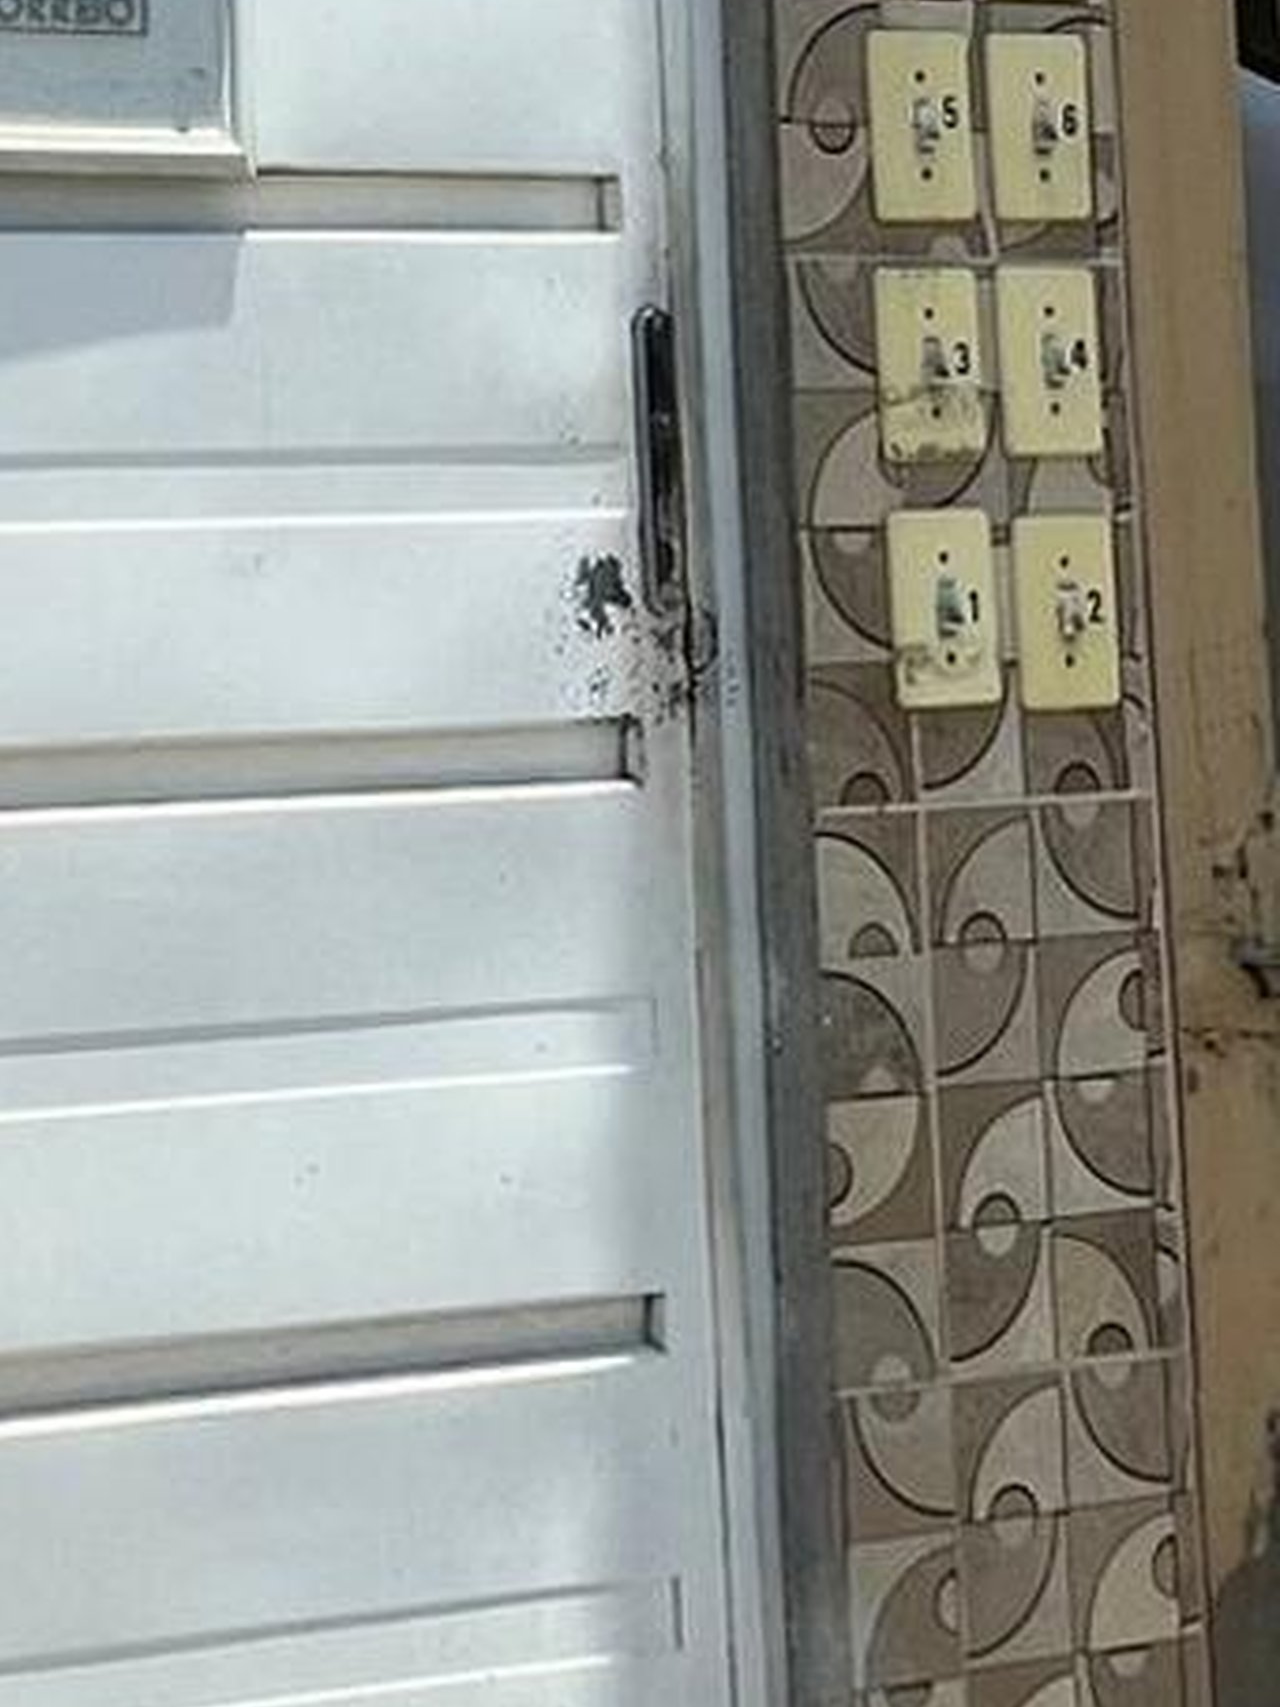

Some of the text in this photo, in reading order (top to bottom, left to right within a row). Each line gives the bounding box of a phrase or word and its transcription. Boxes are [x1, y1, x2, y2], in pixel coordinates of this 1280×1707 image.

[942, 95, 959, 129] 5
[1062, 102, 1079, 136] 6
[953, 341, 971, 376] 3
[1068, 338, 1089, 372] 4
[968, 589, 980, 623] 1
[1086, 588, 1105, 624] 2
